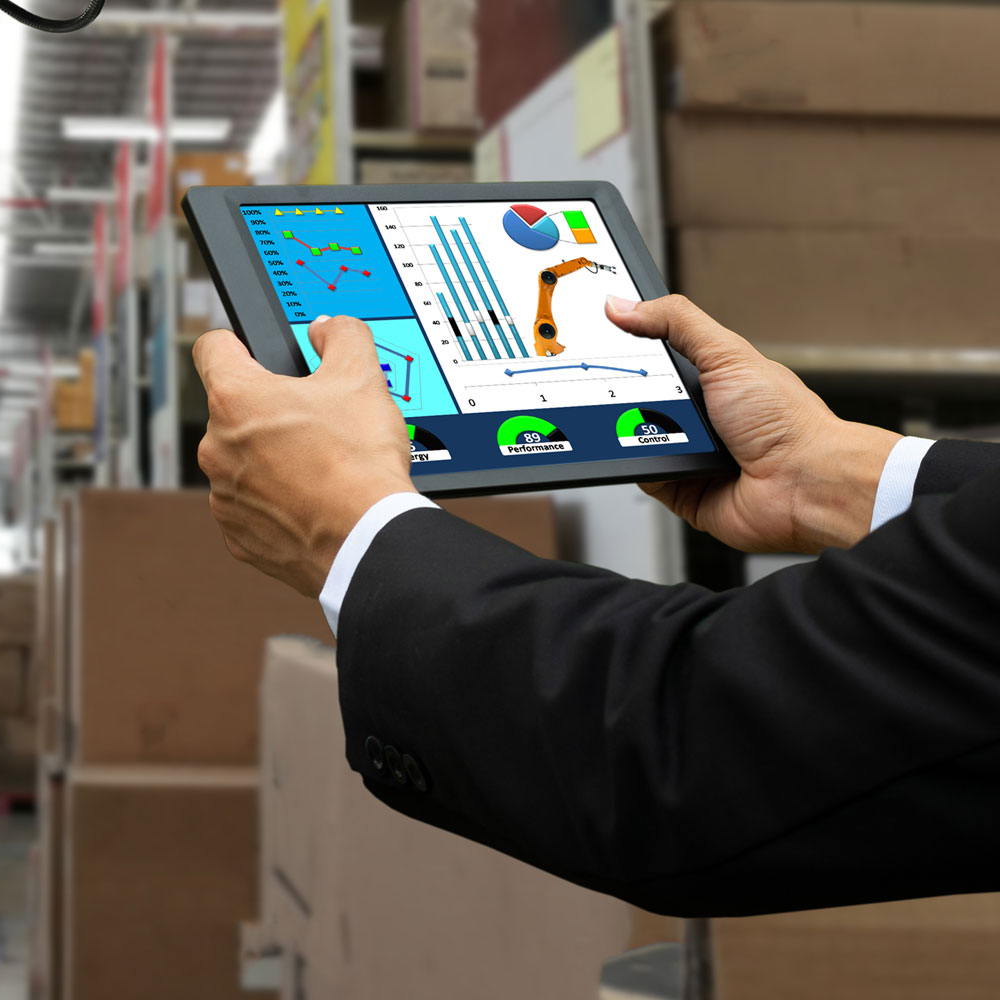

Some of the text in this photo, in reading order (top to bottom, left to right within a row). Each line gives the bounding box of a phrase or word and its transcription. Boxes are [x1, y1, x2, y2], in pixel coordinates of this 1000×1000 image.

[468, 385, 684, 407] 0 1 2 3
[641, 425, 658, 435] 50
[523, 432, 541, 443] 89
[638, 435, 669, 444] Control
[508, 443, 564, 453] Performance
[410, 453, 429, 461] ergy
